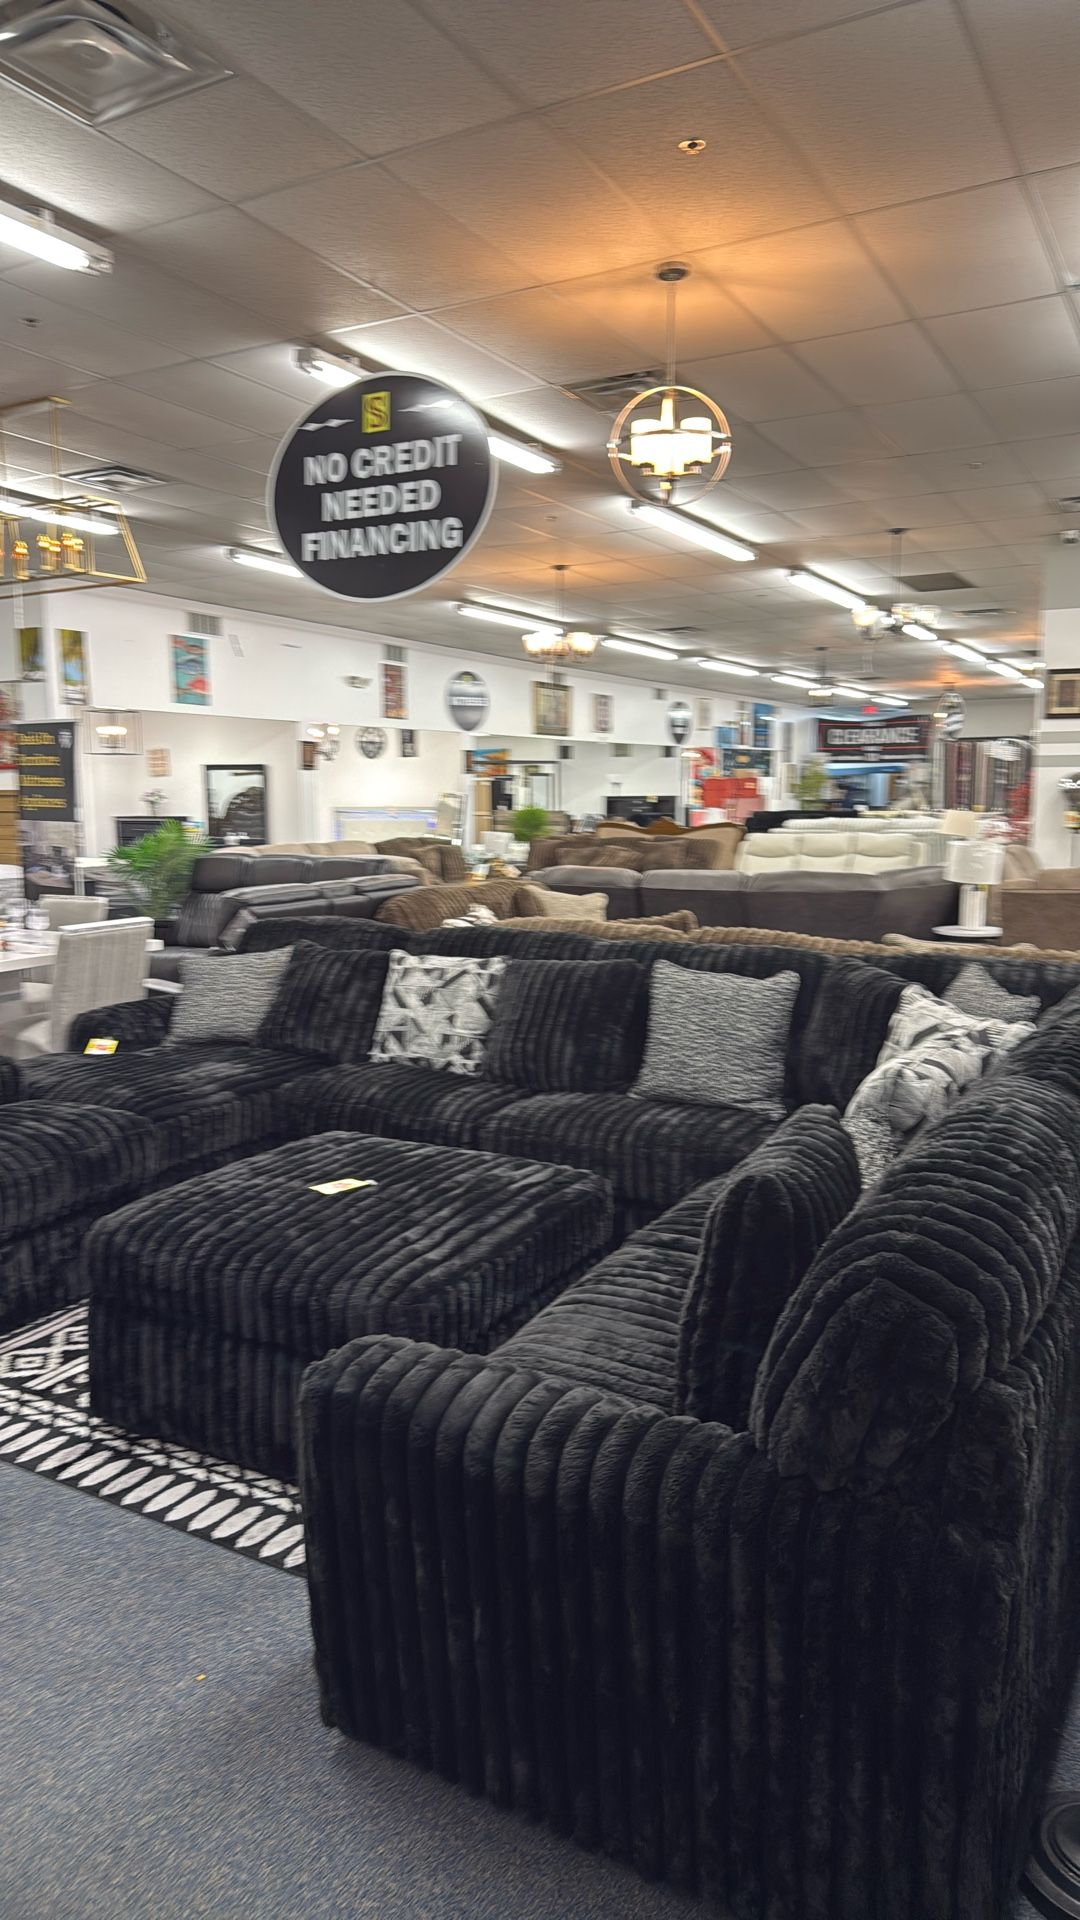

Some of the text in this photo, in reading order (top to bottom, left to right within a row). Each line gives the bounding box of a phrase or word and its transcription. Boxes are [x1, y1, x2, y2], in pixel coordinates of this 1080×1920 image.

[303, 434, 463, 486] NO CREDIT
[321, 479, 442, 522] NEEDED
[301, 517, 464, 562] FINANCING
